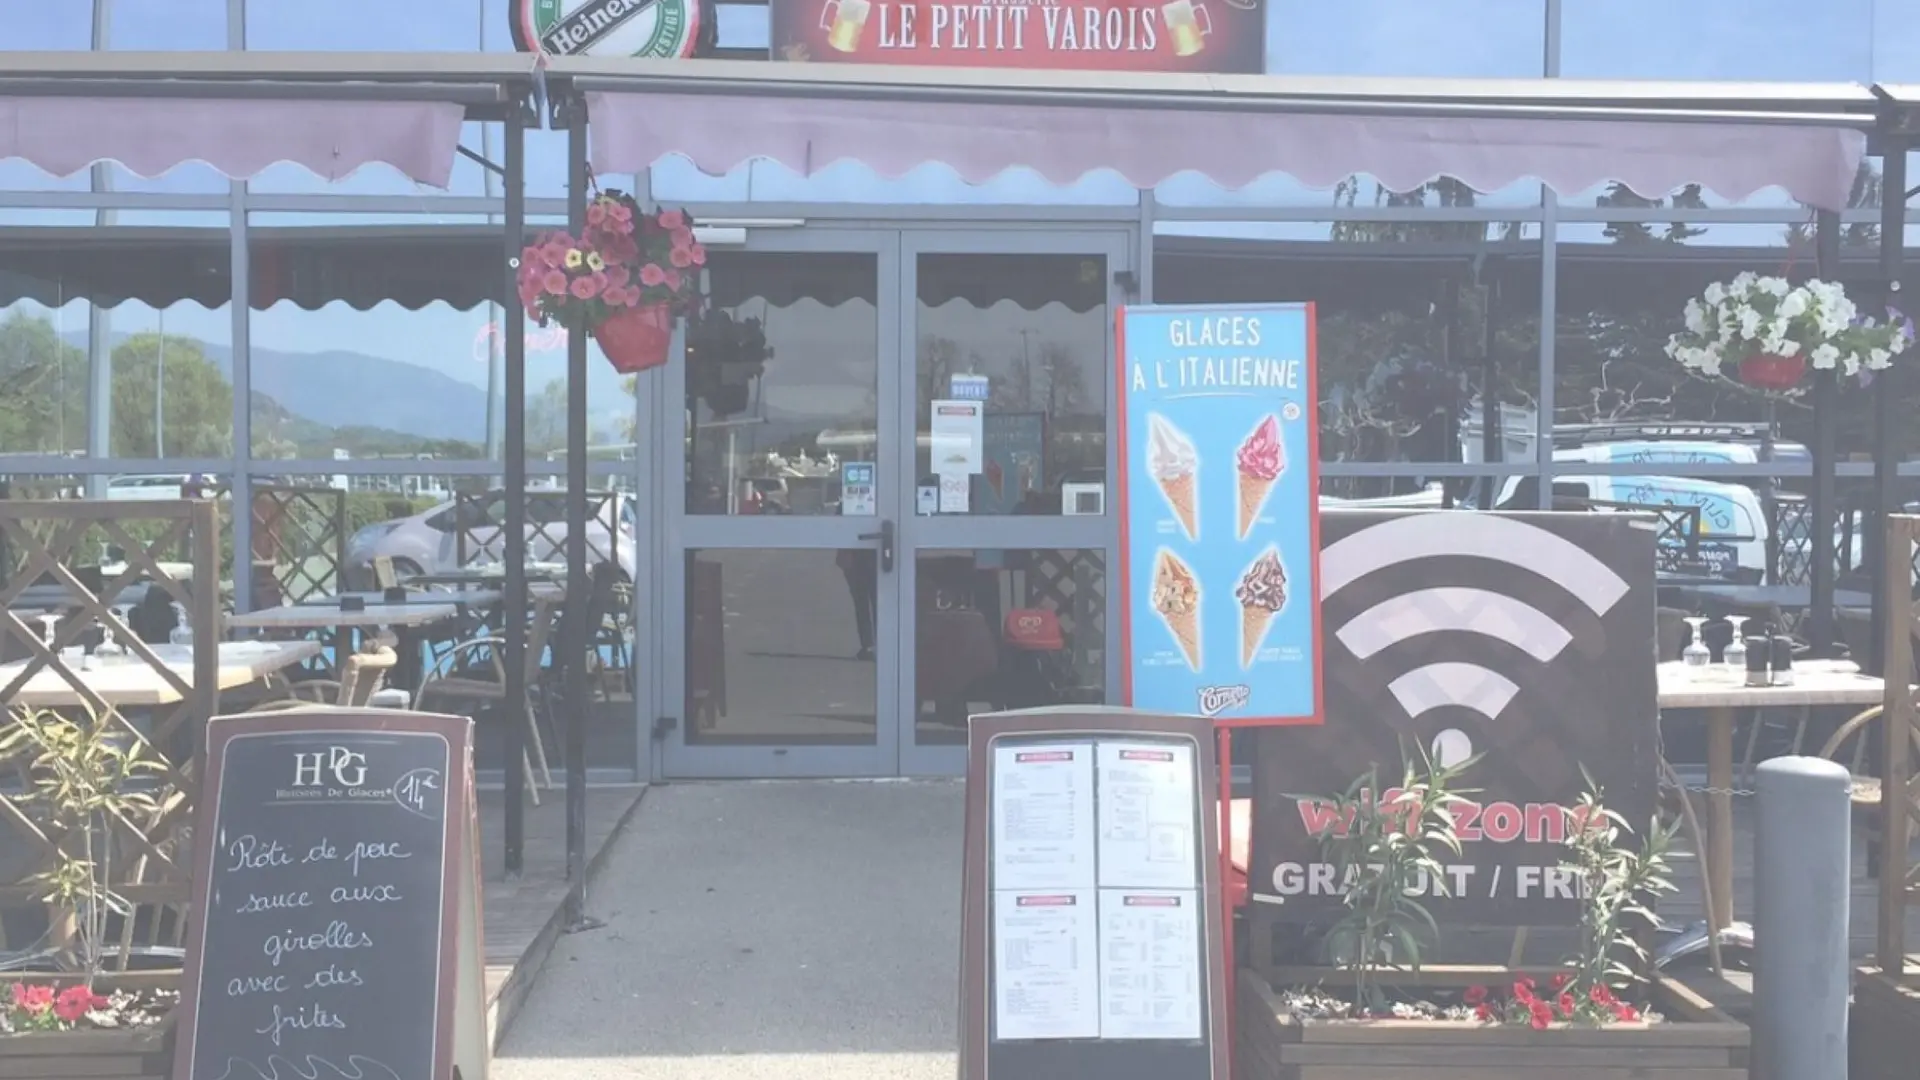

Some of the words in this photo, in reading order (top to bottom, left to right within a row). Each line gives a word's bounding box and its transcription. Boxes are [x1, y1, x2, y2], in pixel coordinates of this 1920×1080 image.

[878, 4, 917, 48] LE
[930, 4, 1029, 50] PETIT
[1042, 6, 1157, 51] VAROIS
[1169, 317, 1262, 347] GLACES
[1133, 357, 1146, 391] À
[292, 746, 368, 786] HDG
[328, 788, 343, 798] De
[1448, 802, 1610, 843] zone
[228, 835, 293, 872] Rôti
[302, 838, 338, 863] de
[236, 891, 313, 913] sauce
[330, 884, 402, 903] aux
[264, 920, 373, 965] girolles
[228, 974, 290, 996] avec
[304, 964, 364, 989] des
[256, 1002, 347, 1046] frites
